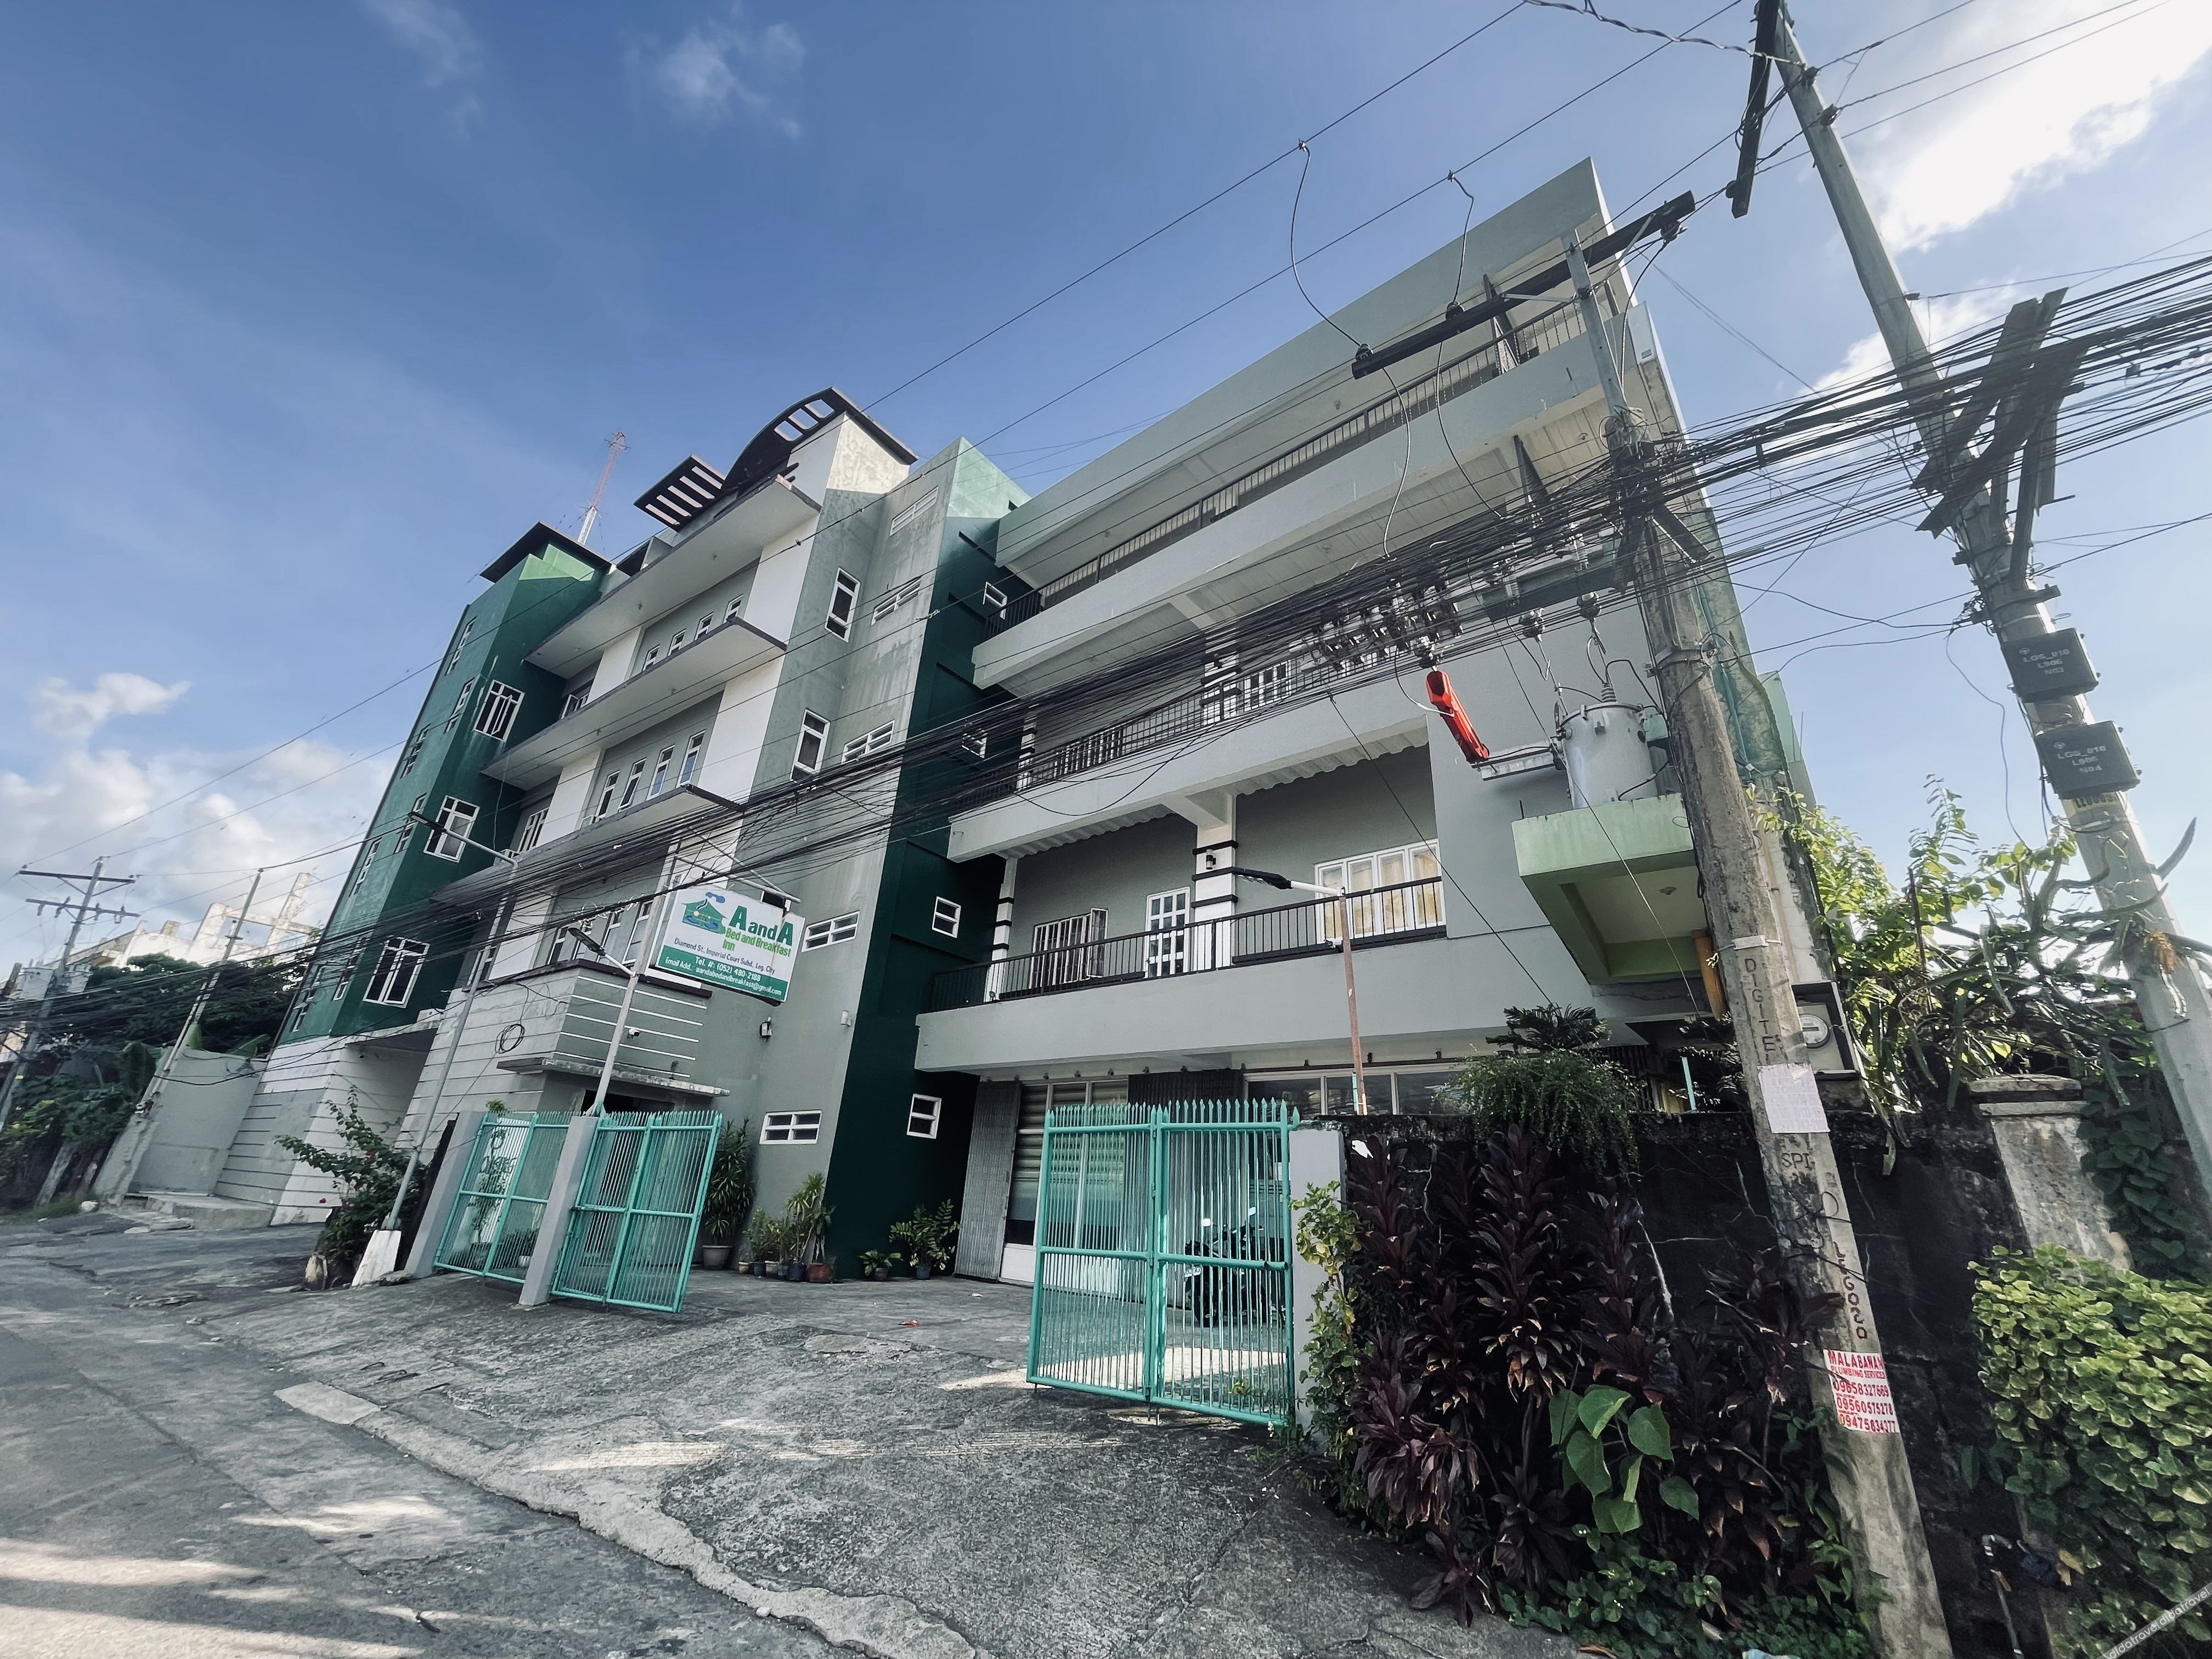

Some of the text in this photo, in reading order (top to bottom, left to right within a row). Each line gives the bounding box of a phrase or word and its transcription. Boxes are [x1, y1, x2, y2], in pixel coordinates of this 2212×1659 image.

[729, 905, 793, 946] A and A
[722, 939, 735, 952] Inn
[725, 928, 792, 957] Bed and Breakfast
[674, 938, 697, 950] Diamond
[706, 948, 726, 959] Imperial
[726, 953, 740, 963] Court
[766, 966, 775, 975] City
[695, 956, 706, 967] Tel.
[716, 963, 733, 974] (052)
[733, 968, 761, 982] 480-2188
[665, 956, 680, 967] Email
[695, 966, 782, 996] aandabedandbreakfast@gmail.com
[1828, 1350, 1884, 1370] MALABANAN
[1830, 1365, 1886, 1379] PLUMBING SERVICES
